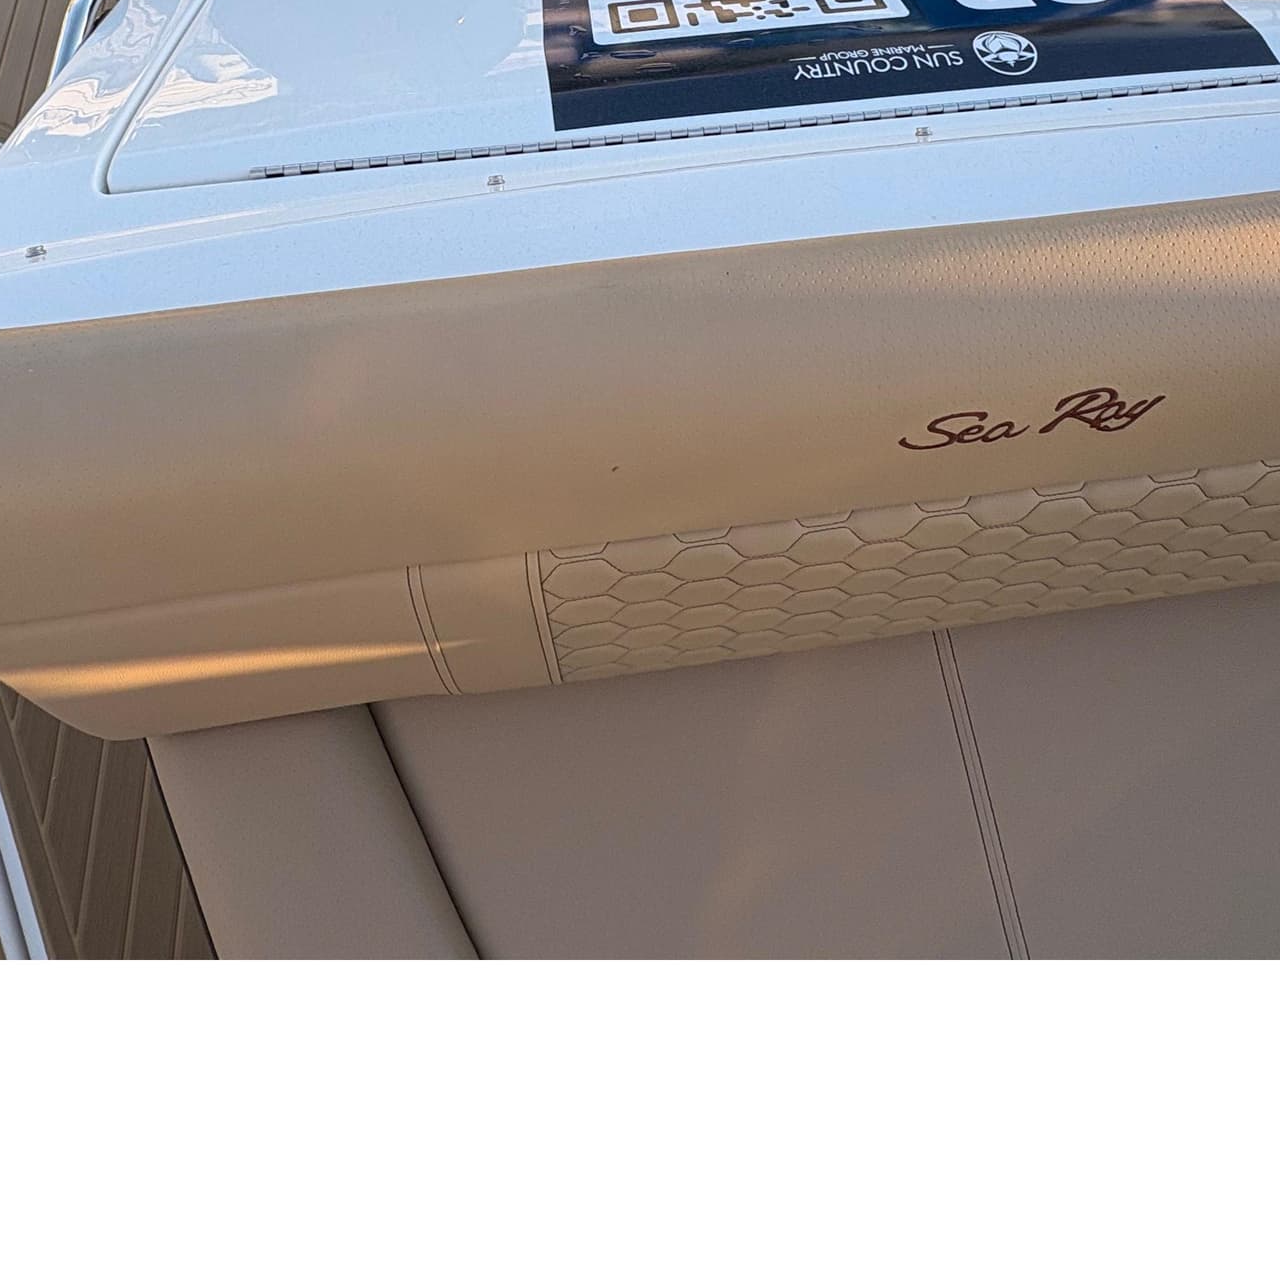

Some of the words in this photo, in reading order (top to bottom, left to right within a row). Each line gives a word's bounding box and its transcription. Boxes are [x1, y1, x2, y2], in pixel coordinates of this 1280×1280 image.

[819, 48, 870, 62] GROUP
[872, 43, 925, 57] MARINE
[916, 50, 964, 70] SUN
[793, 55, 909, 81] COUNTRY
[898, 411, 1030, 450] Sea
[1038, 387, 1166, 434] Ray
